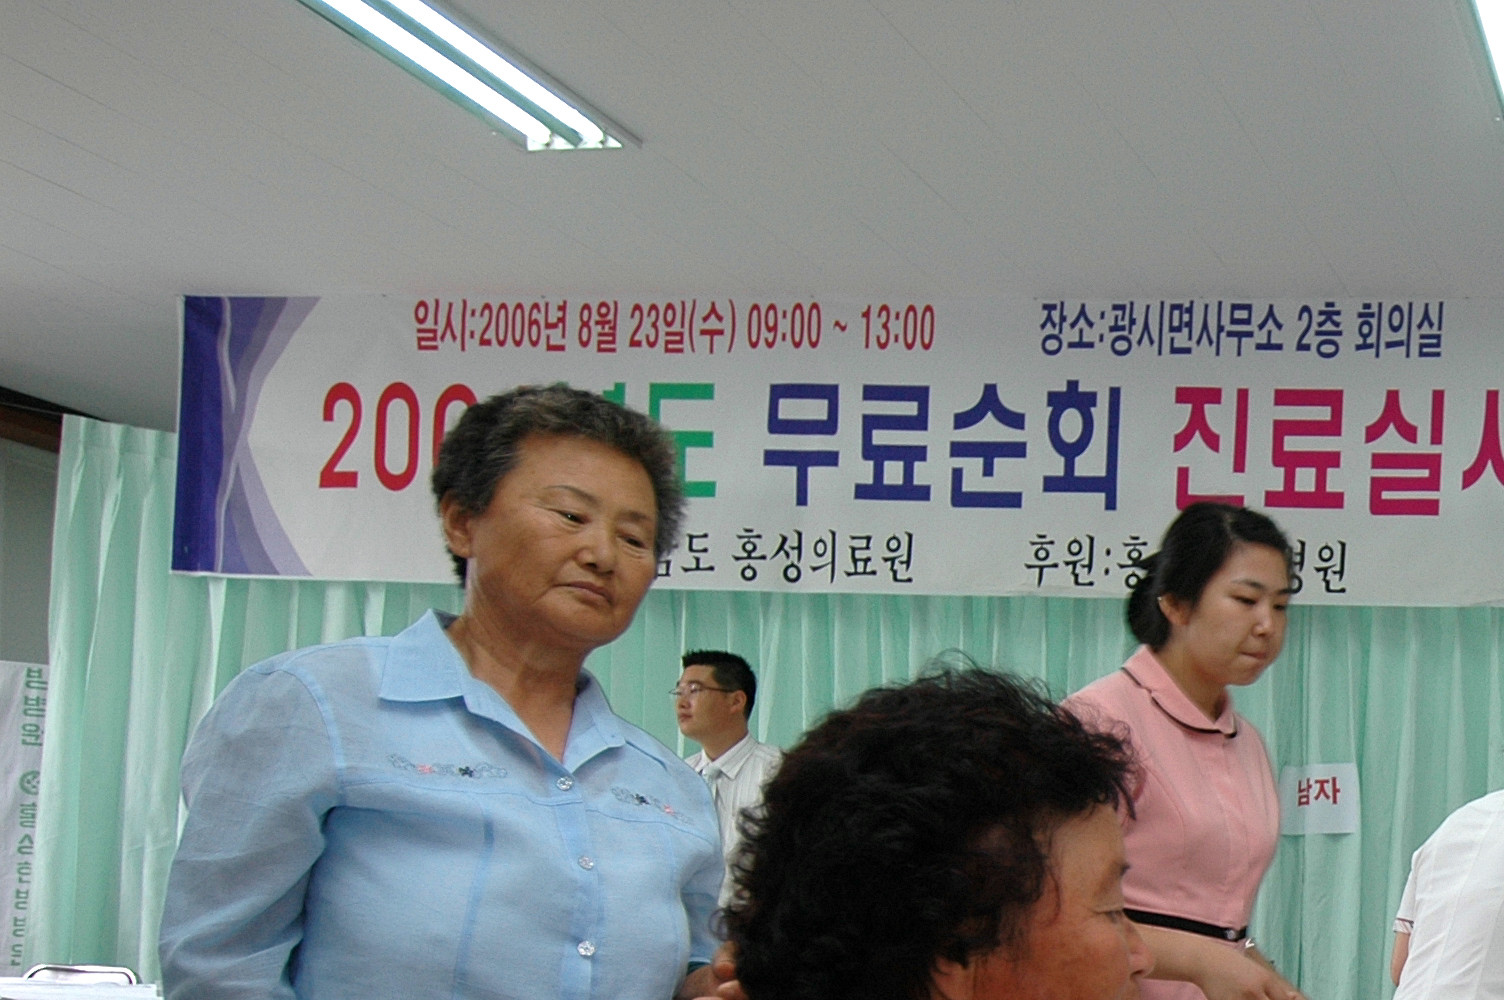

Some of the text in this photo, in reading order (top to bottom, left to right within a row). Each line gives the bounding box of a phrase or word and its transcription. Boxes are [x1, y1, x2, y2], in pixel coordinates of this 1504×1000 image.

[414, 299, 567, 351] 일시:2006년
[578, 300, 618, 353] 8월
[629, 299, 736, 354] 23일(수)
[747, 302, 821, 349] 09:00
[861, 304, 935, 350] 13:00
[1040, 300, 1444, 358] 장소:광시면사무소 2층 회의실
[763, 380, 1121, 511] 무료순회
[731, 528, 914, 585] 홍성의료원
[1297, 776, 1341, 807] 남자
